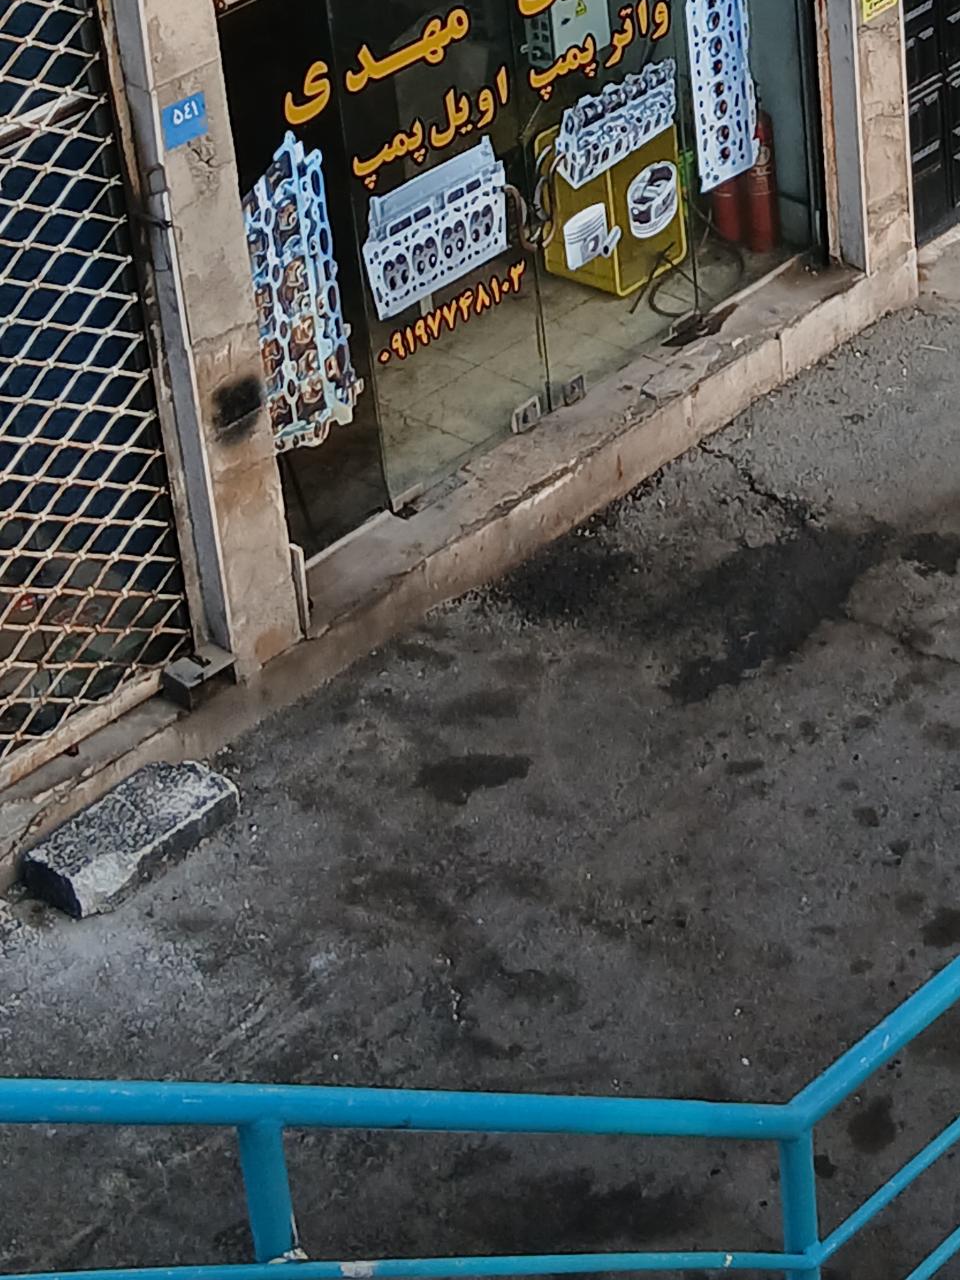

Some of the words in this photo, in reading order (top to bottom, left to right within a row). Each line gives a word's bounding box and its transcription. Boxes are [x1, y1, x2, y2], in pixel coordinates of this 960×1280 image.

[284, 3, 471, 126] مهدی
[529, 30, 595, 100] پمپ
[428, 66, 509, 144] اویل
[351, 117, 425, 188] پمپ
[378, 260, 527, 365] ۰۹۱۹۷۷۴۸۱۰۳
